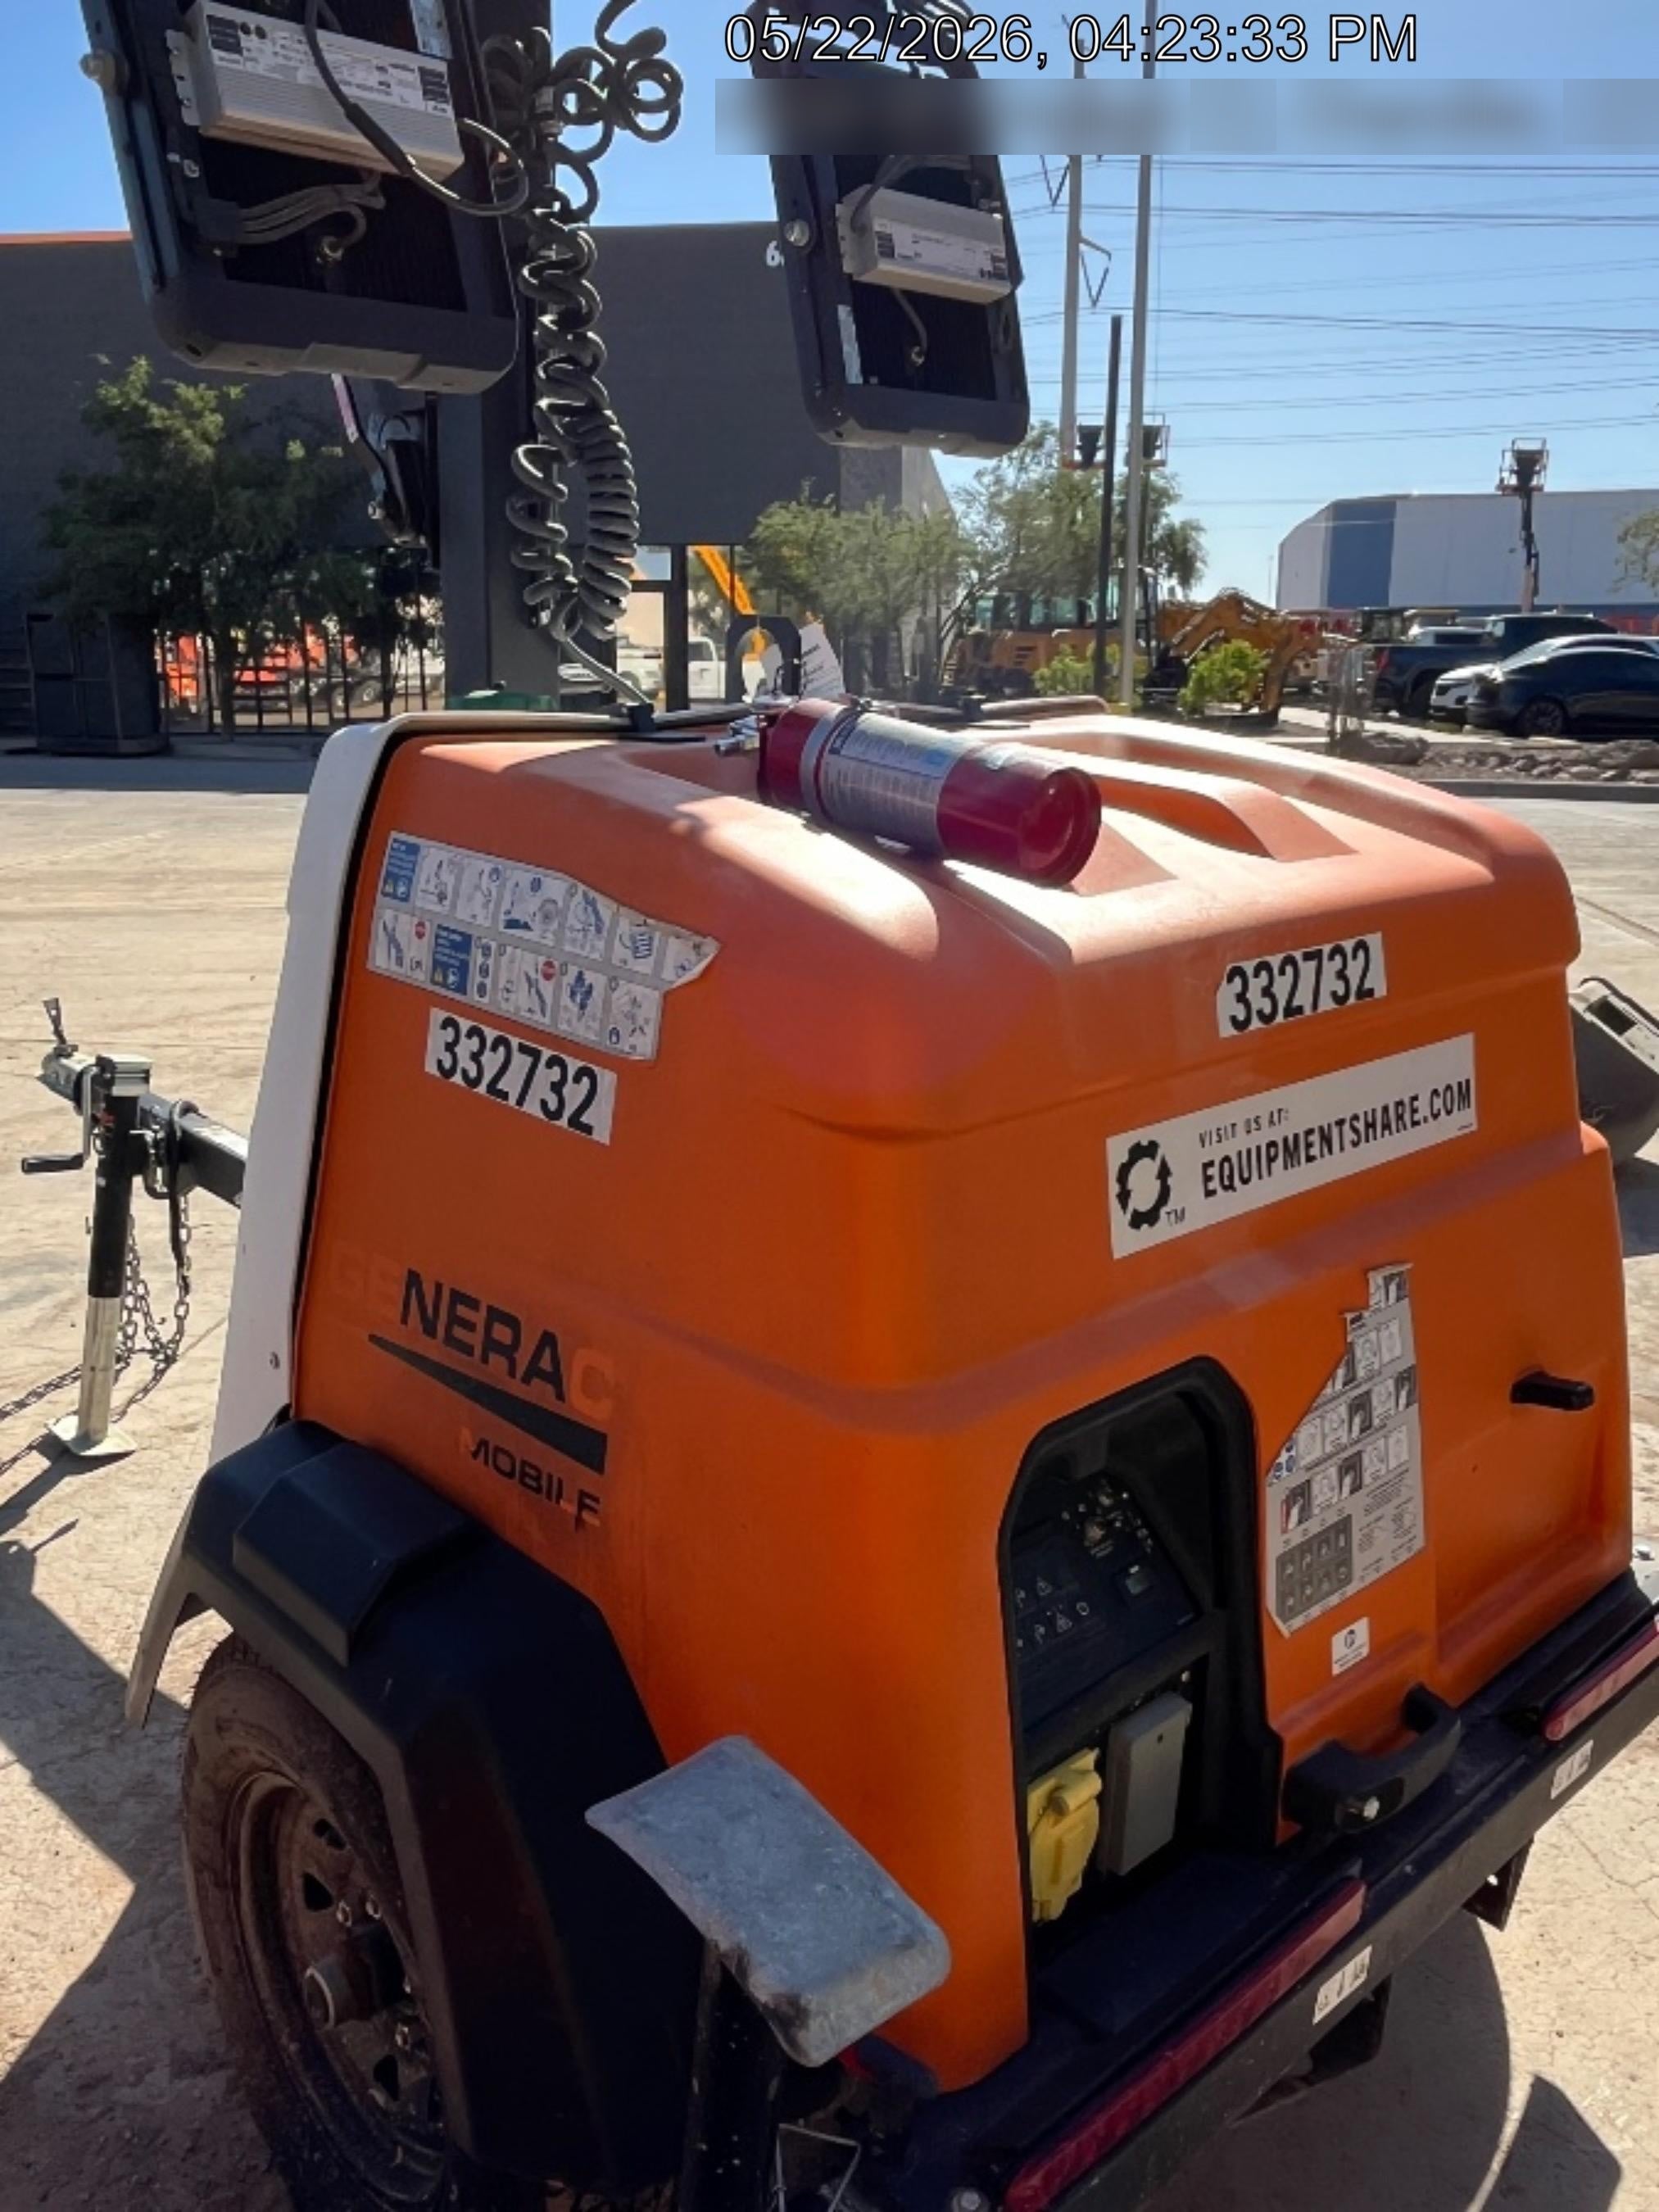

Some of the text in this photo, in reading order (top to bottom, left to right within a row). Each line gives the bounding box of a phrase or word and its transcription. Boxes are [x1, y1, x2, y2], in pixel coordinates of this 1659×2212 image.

[1226, 938, 1375, 1032] 332732
[436, 1016, 599, 1136] 332732
[1199, 1122, 1237, 1149] VISIT
[1244, 1115, 1262, 1135] US
[1201, 1078, 1472, 1199] EQUIPMENTSHARE.COM
[1165, 1206, 1185, 1226] TM
